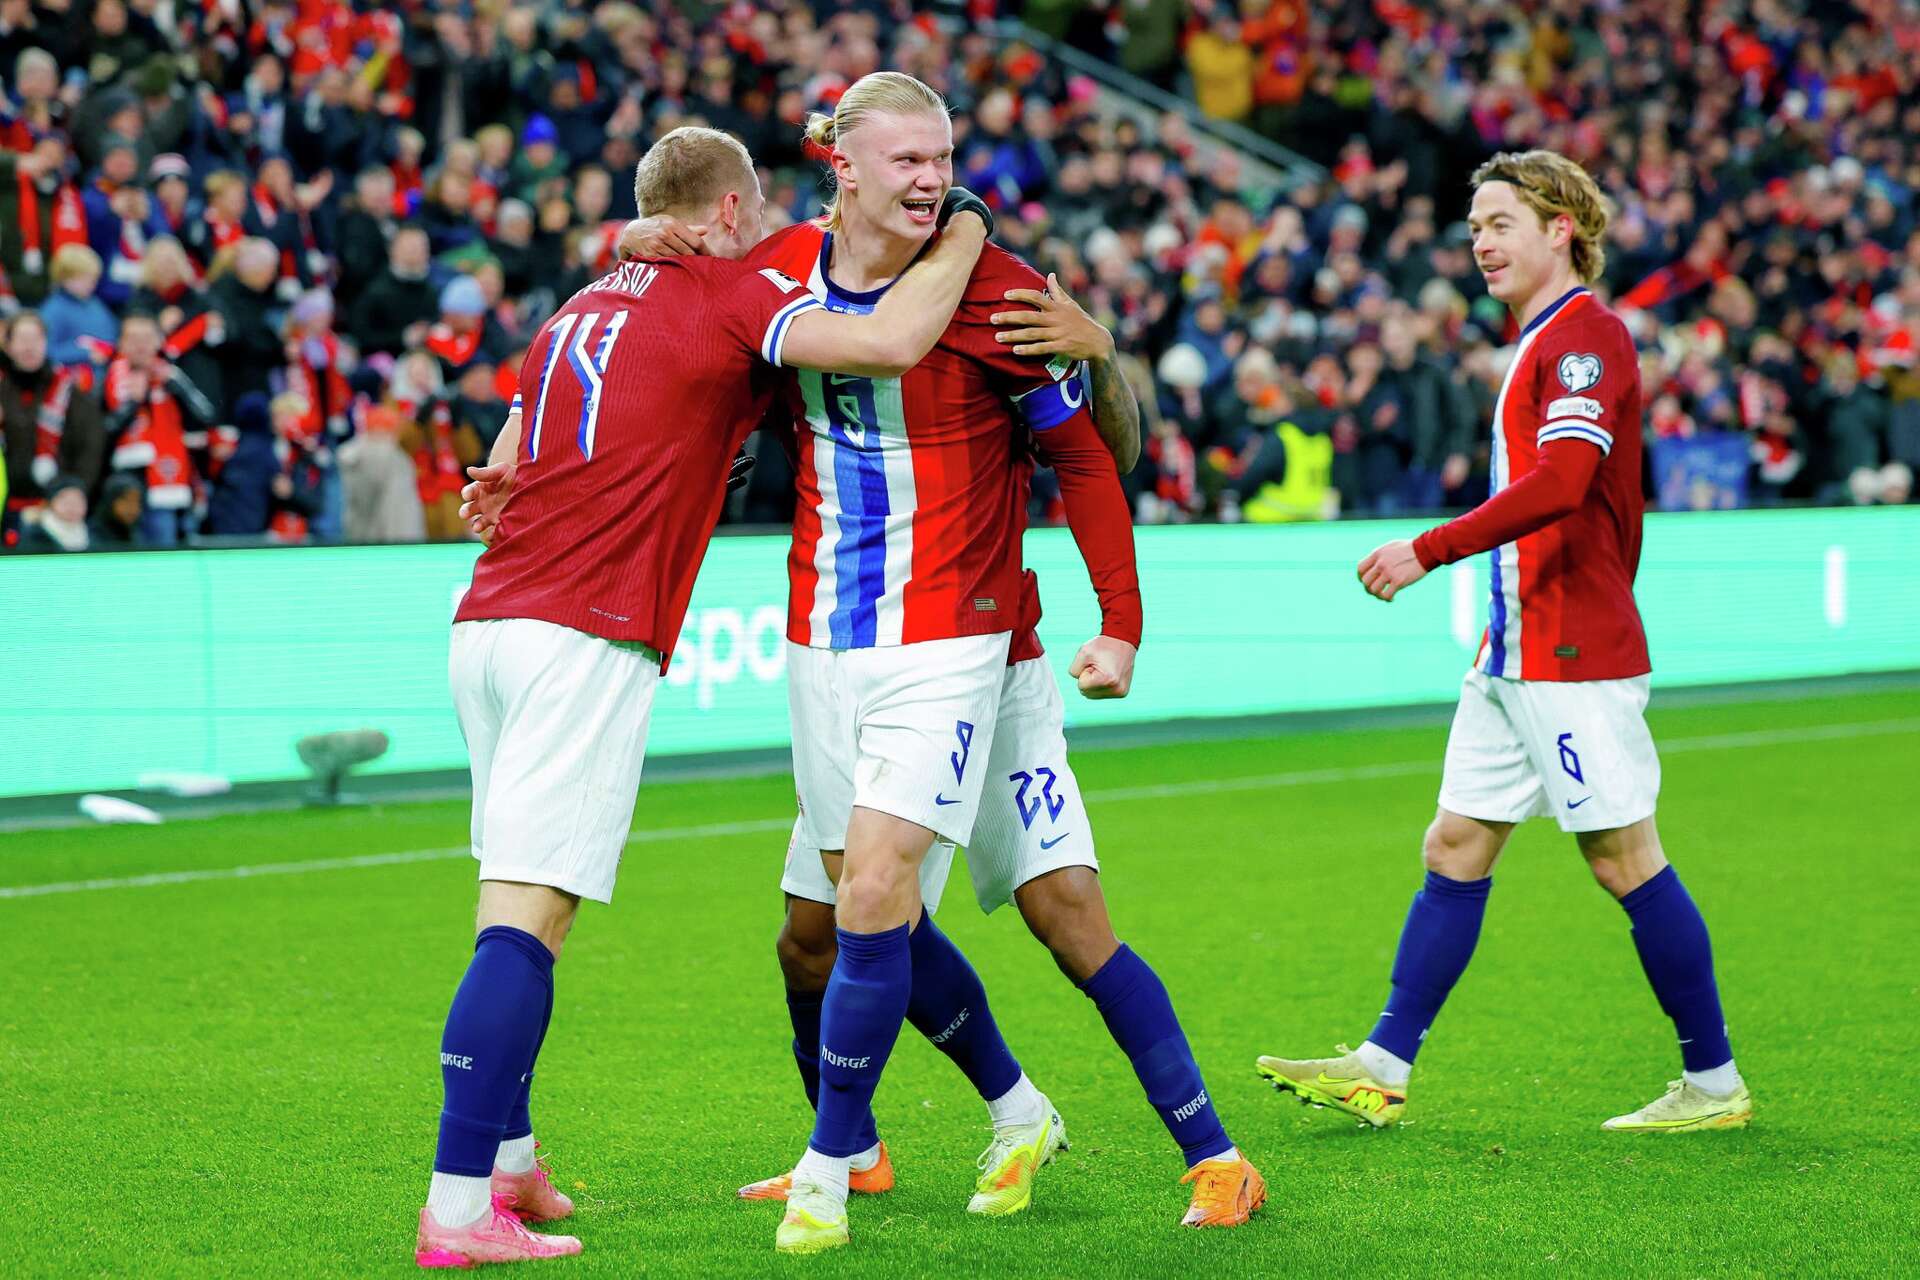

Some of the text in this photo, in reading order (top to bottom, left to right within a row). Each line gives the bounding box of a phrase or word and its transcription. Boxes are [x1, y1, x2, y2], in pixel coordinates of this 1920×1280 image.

[567, 262, 659, 304] ERSON
[528, 310, 629, 463] 14
[951, 719, 974, 787] 9
[1557, 732, 1585, 785] 6
[1009, 766, 1065, 832] 22
[440, 1052, 473, 1071] ORGE
